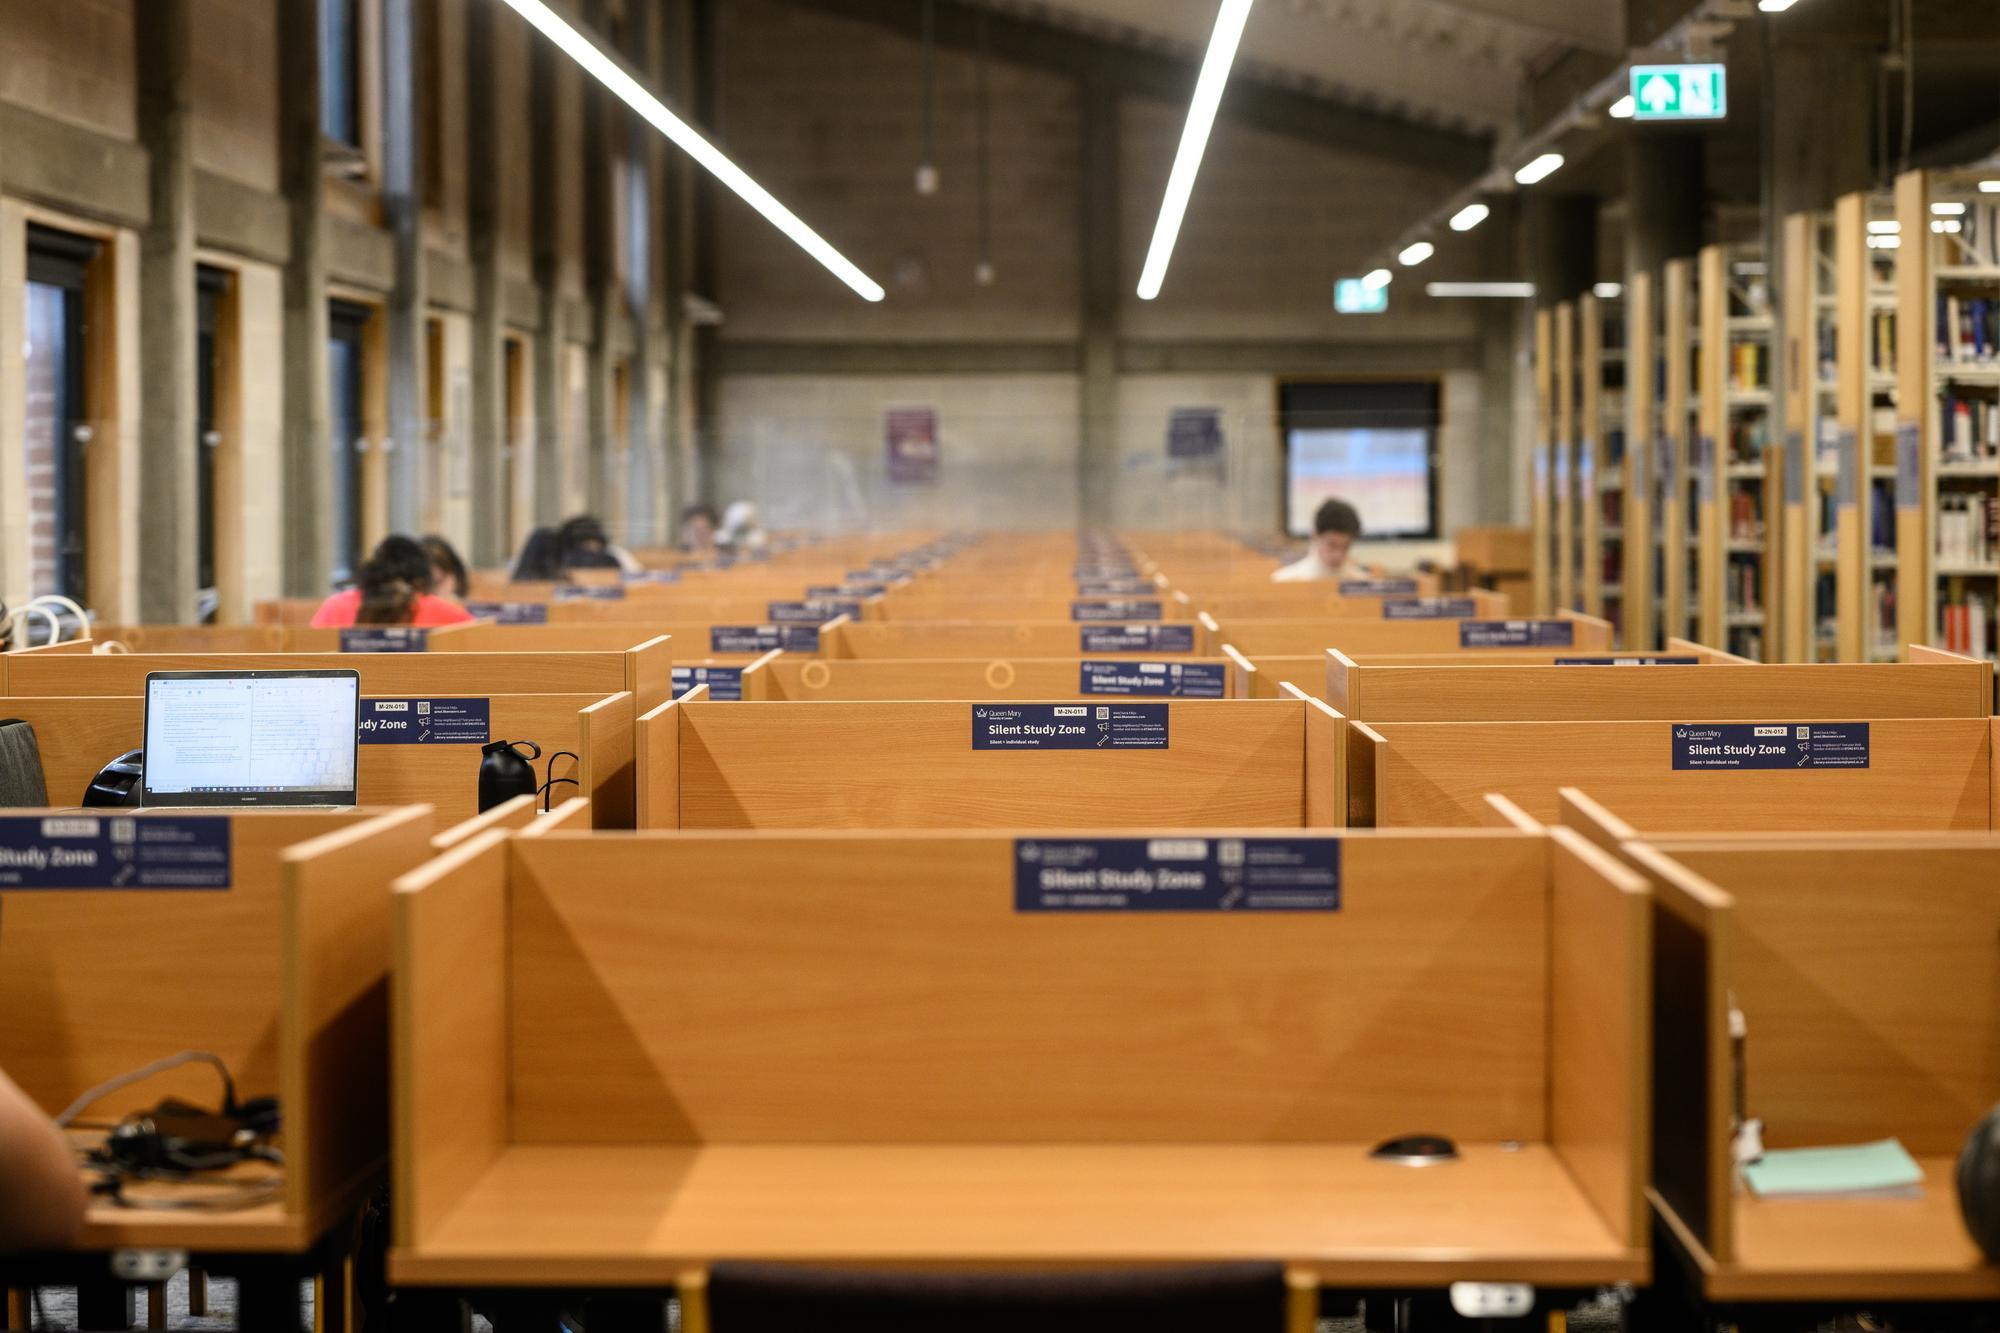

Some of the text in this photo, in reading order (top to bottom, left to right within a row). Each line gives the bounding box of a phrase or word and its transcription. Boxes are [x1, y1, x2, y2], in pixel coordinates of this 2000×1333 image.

[988, 710, 1022, 719] Queen Mary
[359, 719, 407, 731] udy Zone
[988, 724, 1086, 737] Silent Study Zone
[1688, 730, 1722, 739] Queen Mary
[1688, 744, 1787, 757] Silent Study Zone
[49, 846, 97, 867] Zone
[1040, 867, 1205, 892] Silent Study Zone
